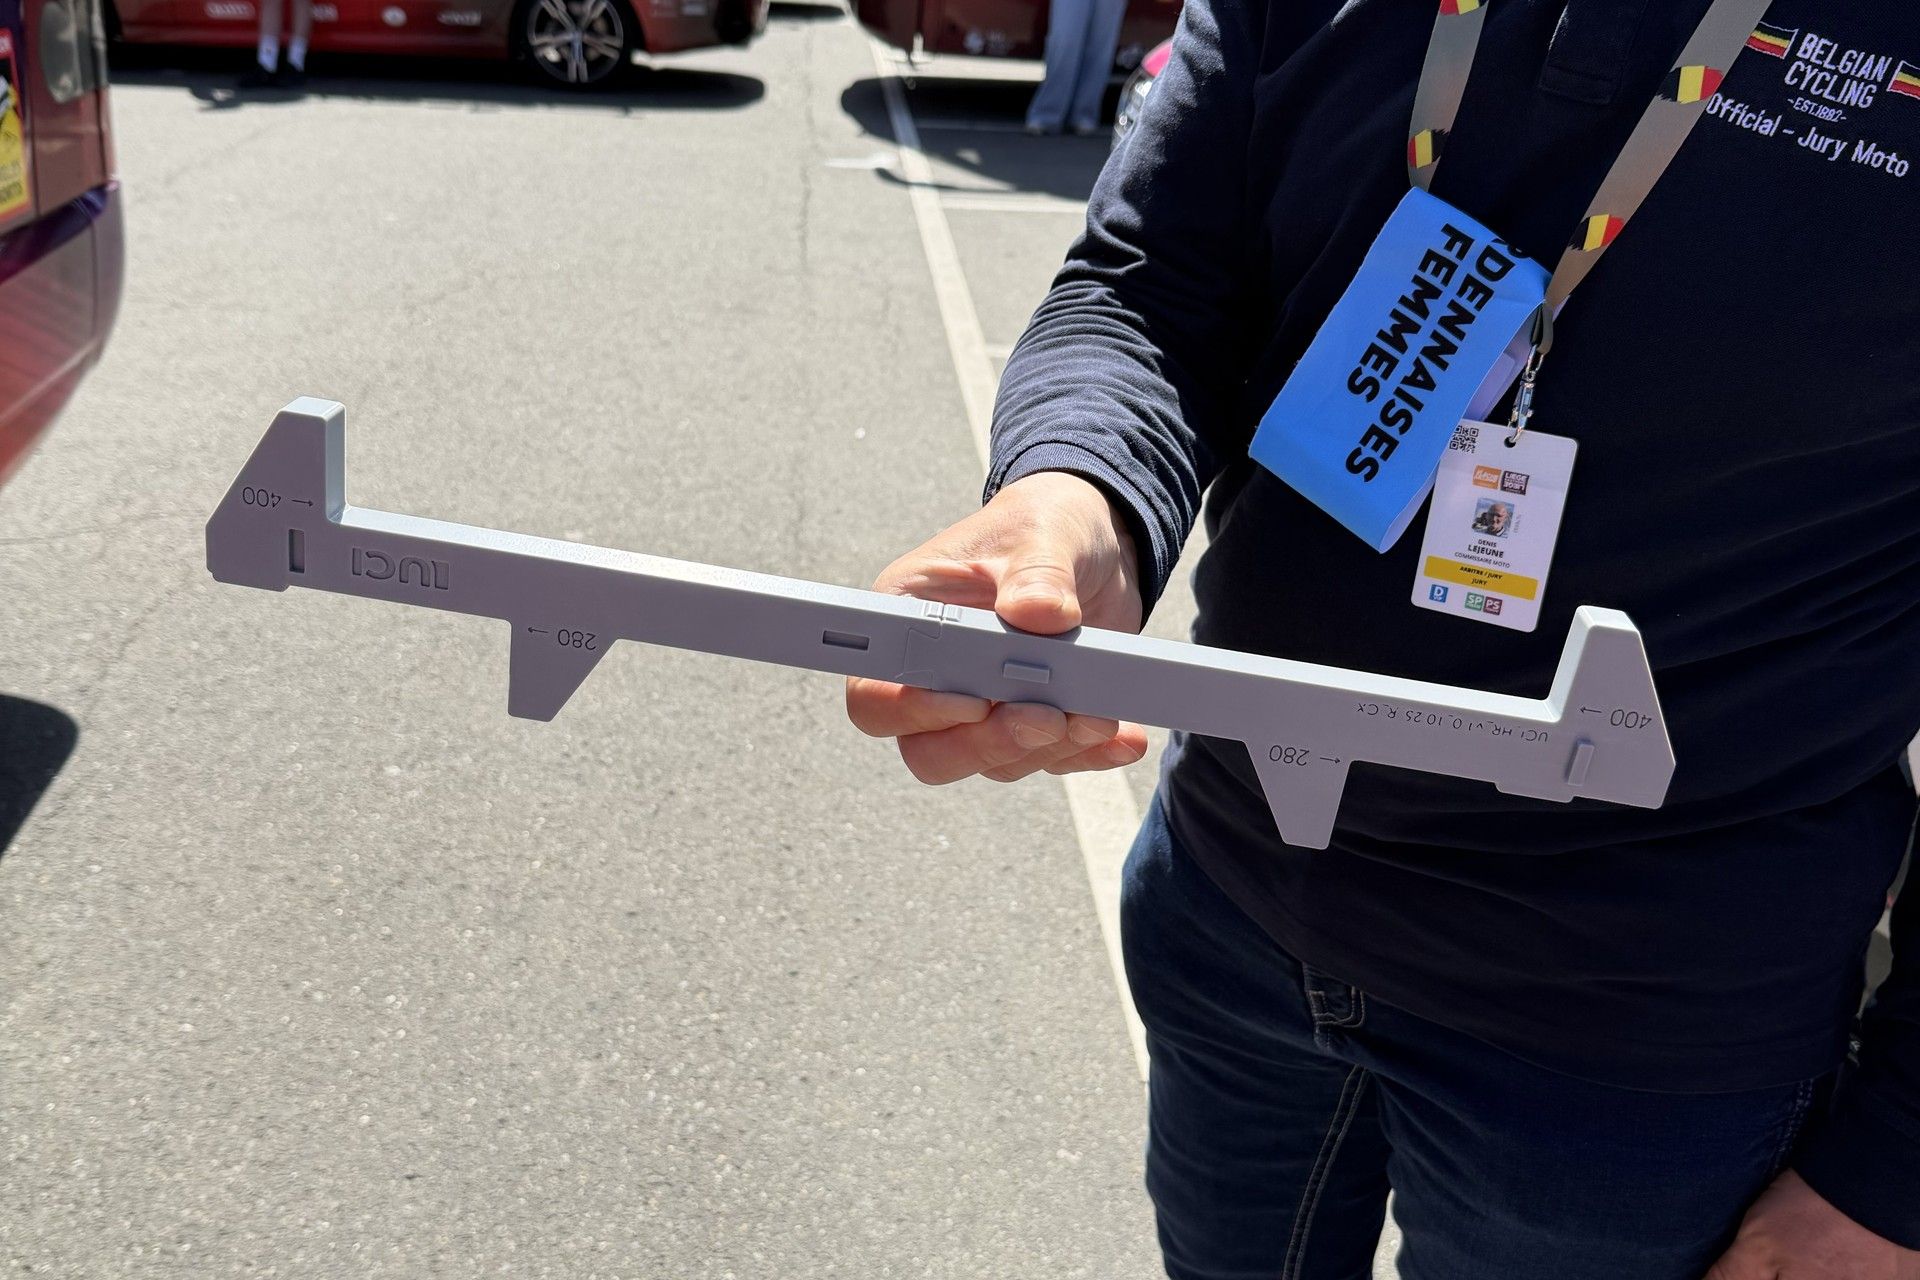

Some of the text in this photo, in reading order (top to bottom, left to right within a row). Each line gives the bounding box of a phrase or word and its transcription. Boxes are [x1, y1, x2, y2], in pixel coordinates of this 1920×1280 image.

[1796, 33, 1892, 82] BELGIAN
[1784, 61, 1877, 108] CYCLING
[1706, 93, 1782, 137] Official
[1797, 127, 1848, 161] Jury
[1851, 140, 1909, 177] Moto
[1347, 223, 1475, 403] FEMMES
[242, 486, 282, 508] 400
[1467, 544, 1504, 558] LEJEUNE
[1478, 539, 1497, 548] DENIS
[1455, 552, 1511, 569] COMMISSAIRE MOTO
[1434, 586, 1444, 597] D
[1468, 594, 1483, 605] SP
[1486, 599, 1500, 610] PS
[557, 628, 598, 651] 280
[1610, 708, 1652, 729] 400
[1269, 744, 1310, 766] 280
